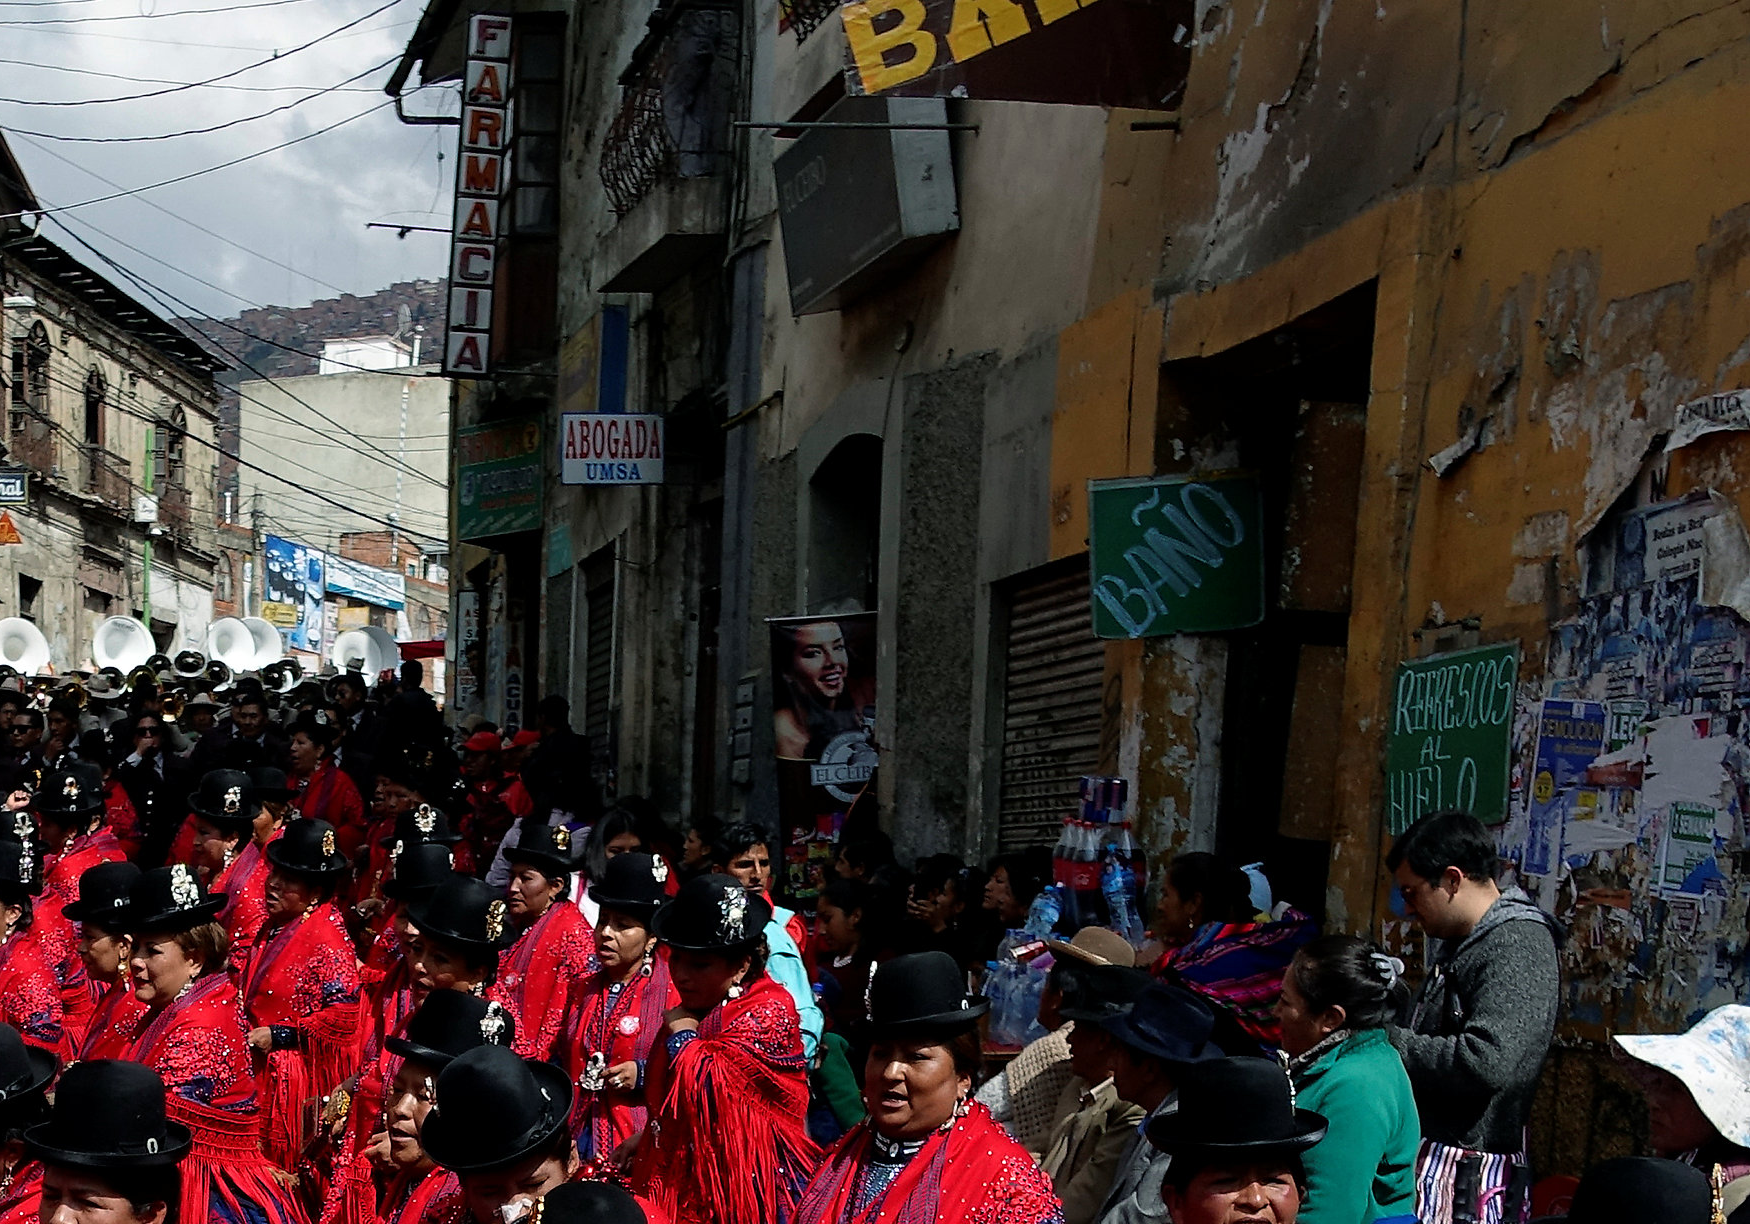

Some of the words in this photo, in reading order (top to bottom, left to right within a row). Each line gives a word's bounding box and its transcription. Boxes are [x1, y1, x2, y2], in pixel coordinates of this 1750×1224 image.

[452, 19, 508, 371] FARMACIA
[565, 419, 660, 459] ABOGADA
[585, 462, 642, 480] UMSA
[1093, 482, 1245, 639] BAÑO
[1394, 655, 1513, 737] REFRESCOS
[1420, 735, 1451, 764] AL
[834, 763, 874, 782] CEIB
